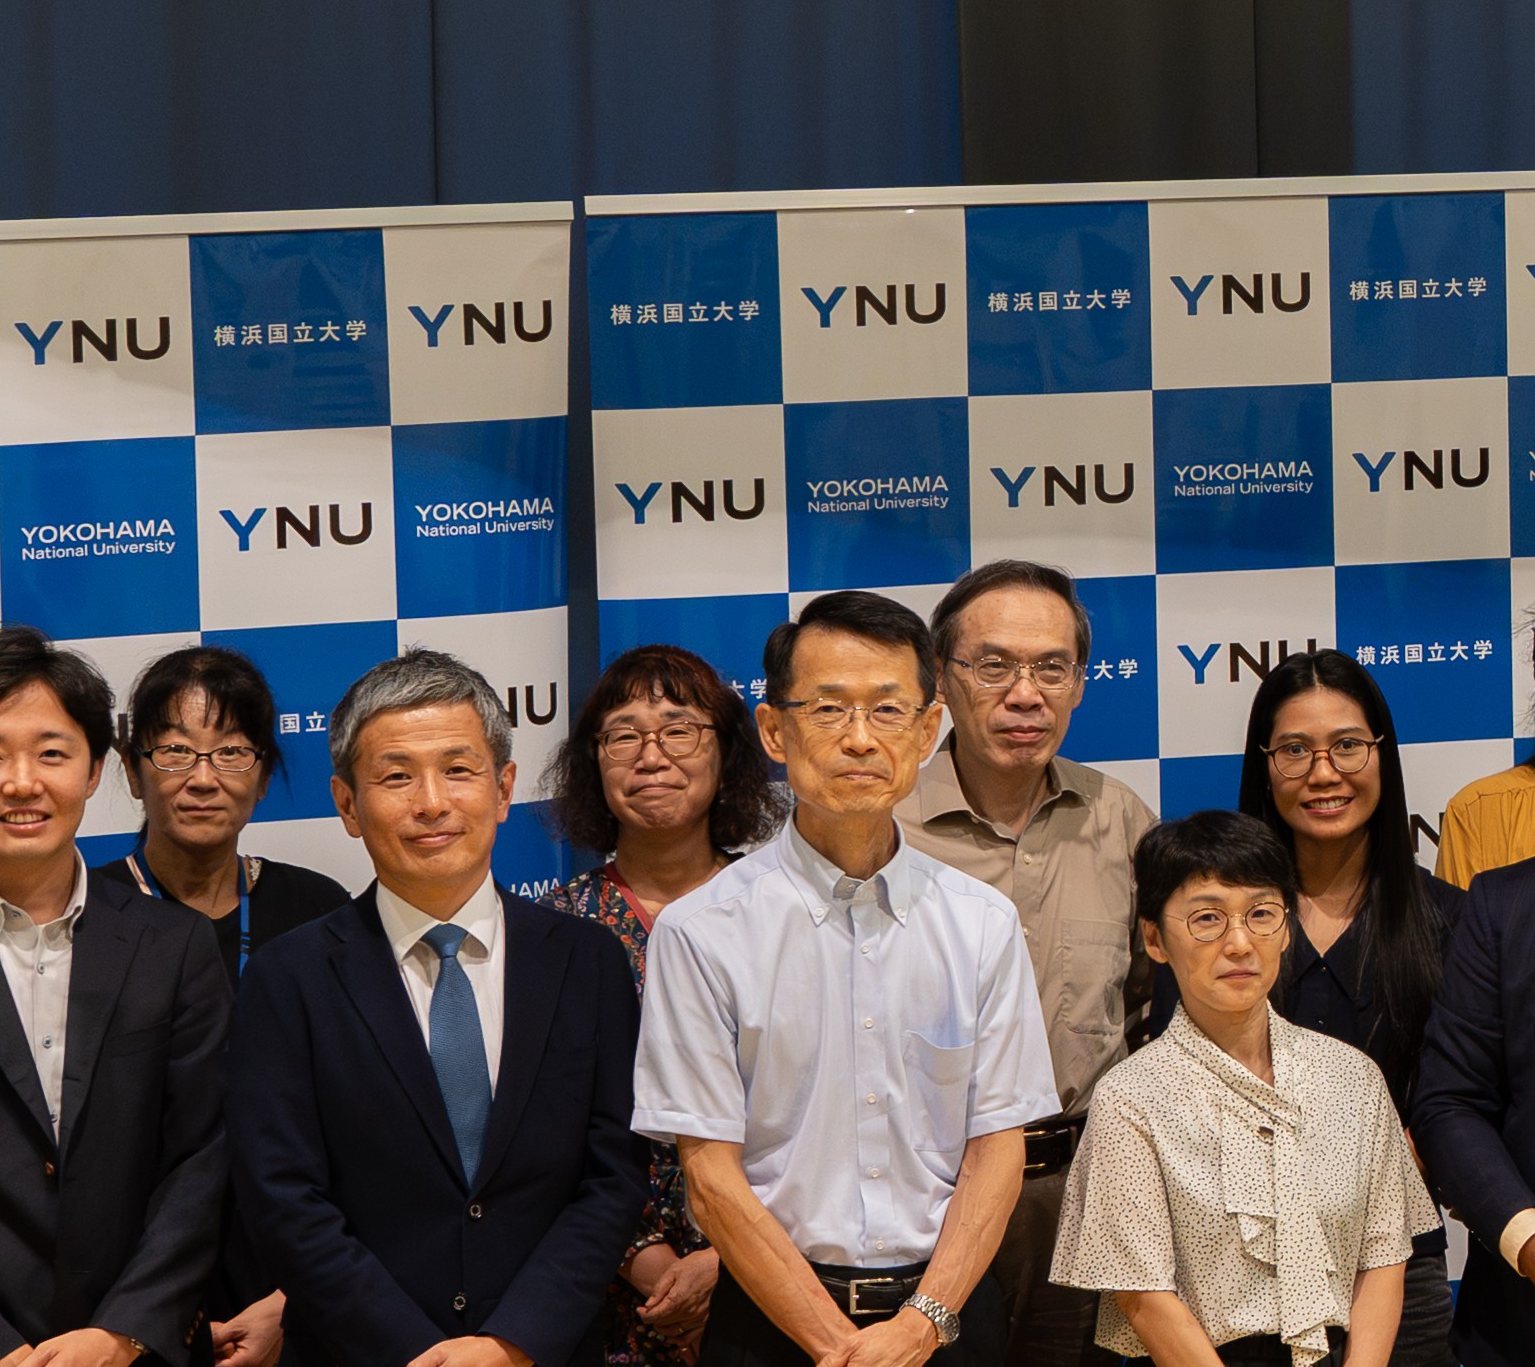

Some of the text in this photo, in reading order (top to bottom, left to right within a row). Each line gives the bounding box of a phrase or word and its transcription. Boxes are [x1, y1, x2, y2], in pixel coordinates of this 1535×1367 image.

[988, 288, 1131, 312] 横浜国立大学
[1170, 272, 1310, 316] YNU
[1350, 276, 1487, 301] 横浜国立大学
[611, 300, 760, 325] 横浜国立大学
[801, 283, 946, 328] YNU
[214, 320, 367, 348] 横浜国立大学
[408, 300, 553, 348] YNU
[15, 316, 170, 365] YNU
[1174, 461, 1312, 483] YOKOHAMA
[1353, 448, 1489, 492] YNU
[807, 475, 948, 496] YOKOHAMA
[991, 463, 1134, 508] YNU
[1175, 478, 1313, 497] National University
[415, 496, 554, 522] YOKOHAMA
[615, 478, 764, 525] YNU
[808, 492, 948, 513] National University
[21, 518, 175, 545] YOKOHAMA
[221, 503, 372, 552] YNU
[416, 517, 554, 538] National University
[22, 540, 175, 561] National University
[1178, 638, 1317, 684] YN
[1356, 639, 1493, 665] 横浜国立大学
